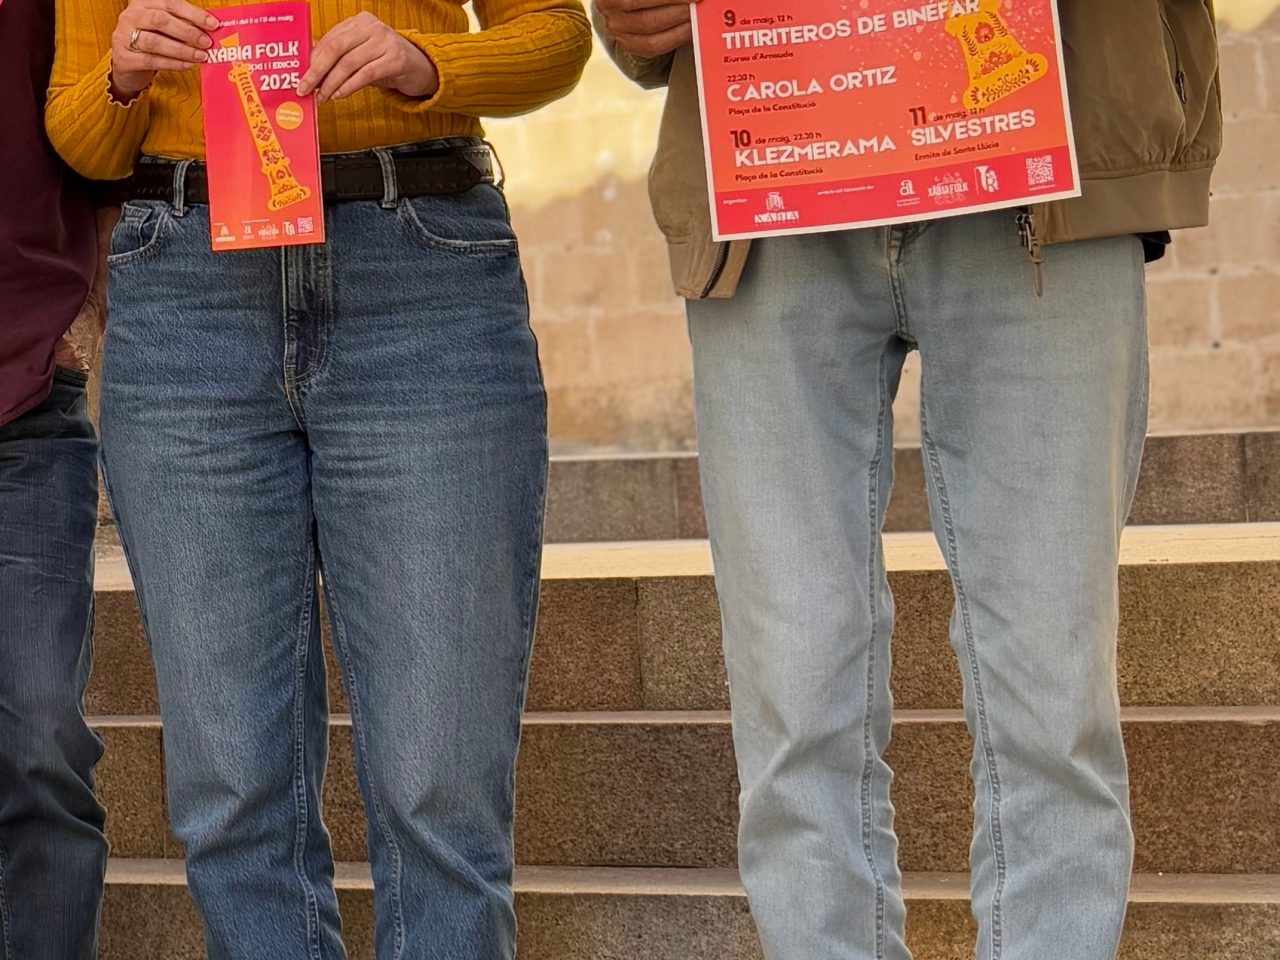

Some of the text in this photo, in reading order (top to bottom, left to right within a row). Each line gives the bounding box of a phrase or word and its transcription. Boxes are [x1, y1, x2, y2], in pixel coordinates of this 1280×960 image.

[724, 10, 736, 27] 9
[722, 19, 852, 50] TITIRITEROS
[857, 14, 887, 35] DE
[256, 41, 299, 59] FOLK
[260, 73, 300, 91] 2025
[727, 66, 897, 102] CAROLA ORTIZ
[729, 108, 750, 116] Plaça
[772, 102, 816, 111] Constitució
[909, 106, 926, 126] 11
[933, 113, 944, 122] de
[911, 109, 1036, 147] SILVESTRES
[730, 130, 751, 148] 10
[755, 137, 766, 145] de
[735, 135, 897, 168] KLEZMERAMA
[915, 142, 1000, 161] Ermita de Santa Llúcia
[735, 167, 823, 182] Plaça de la Constitució
